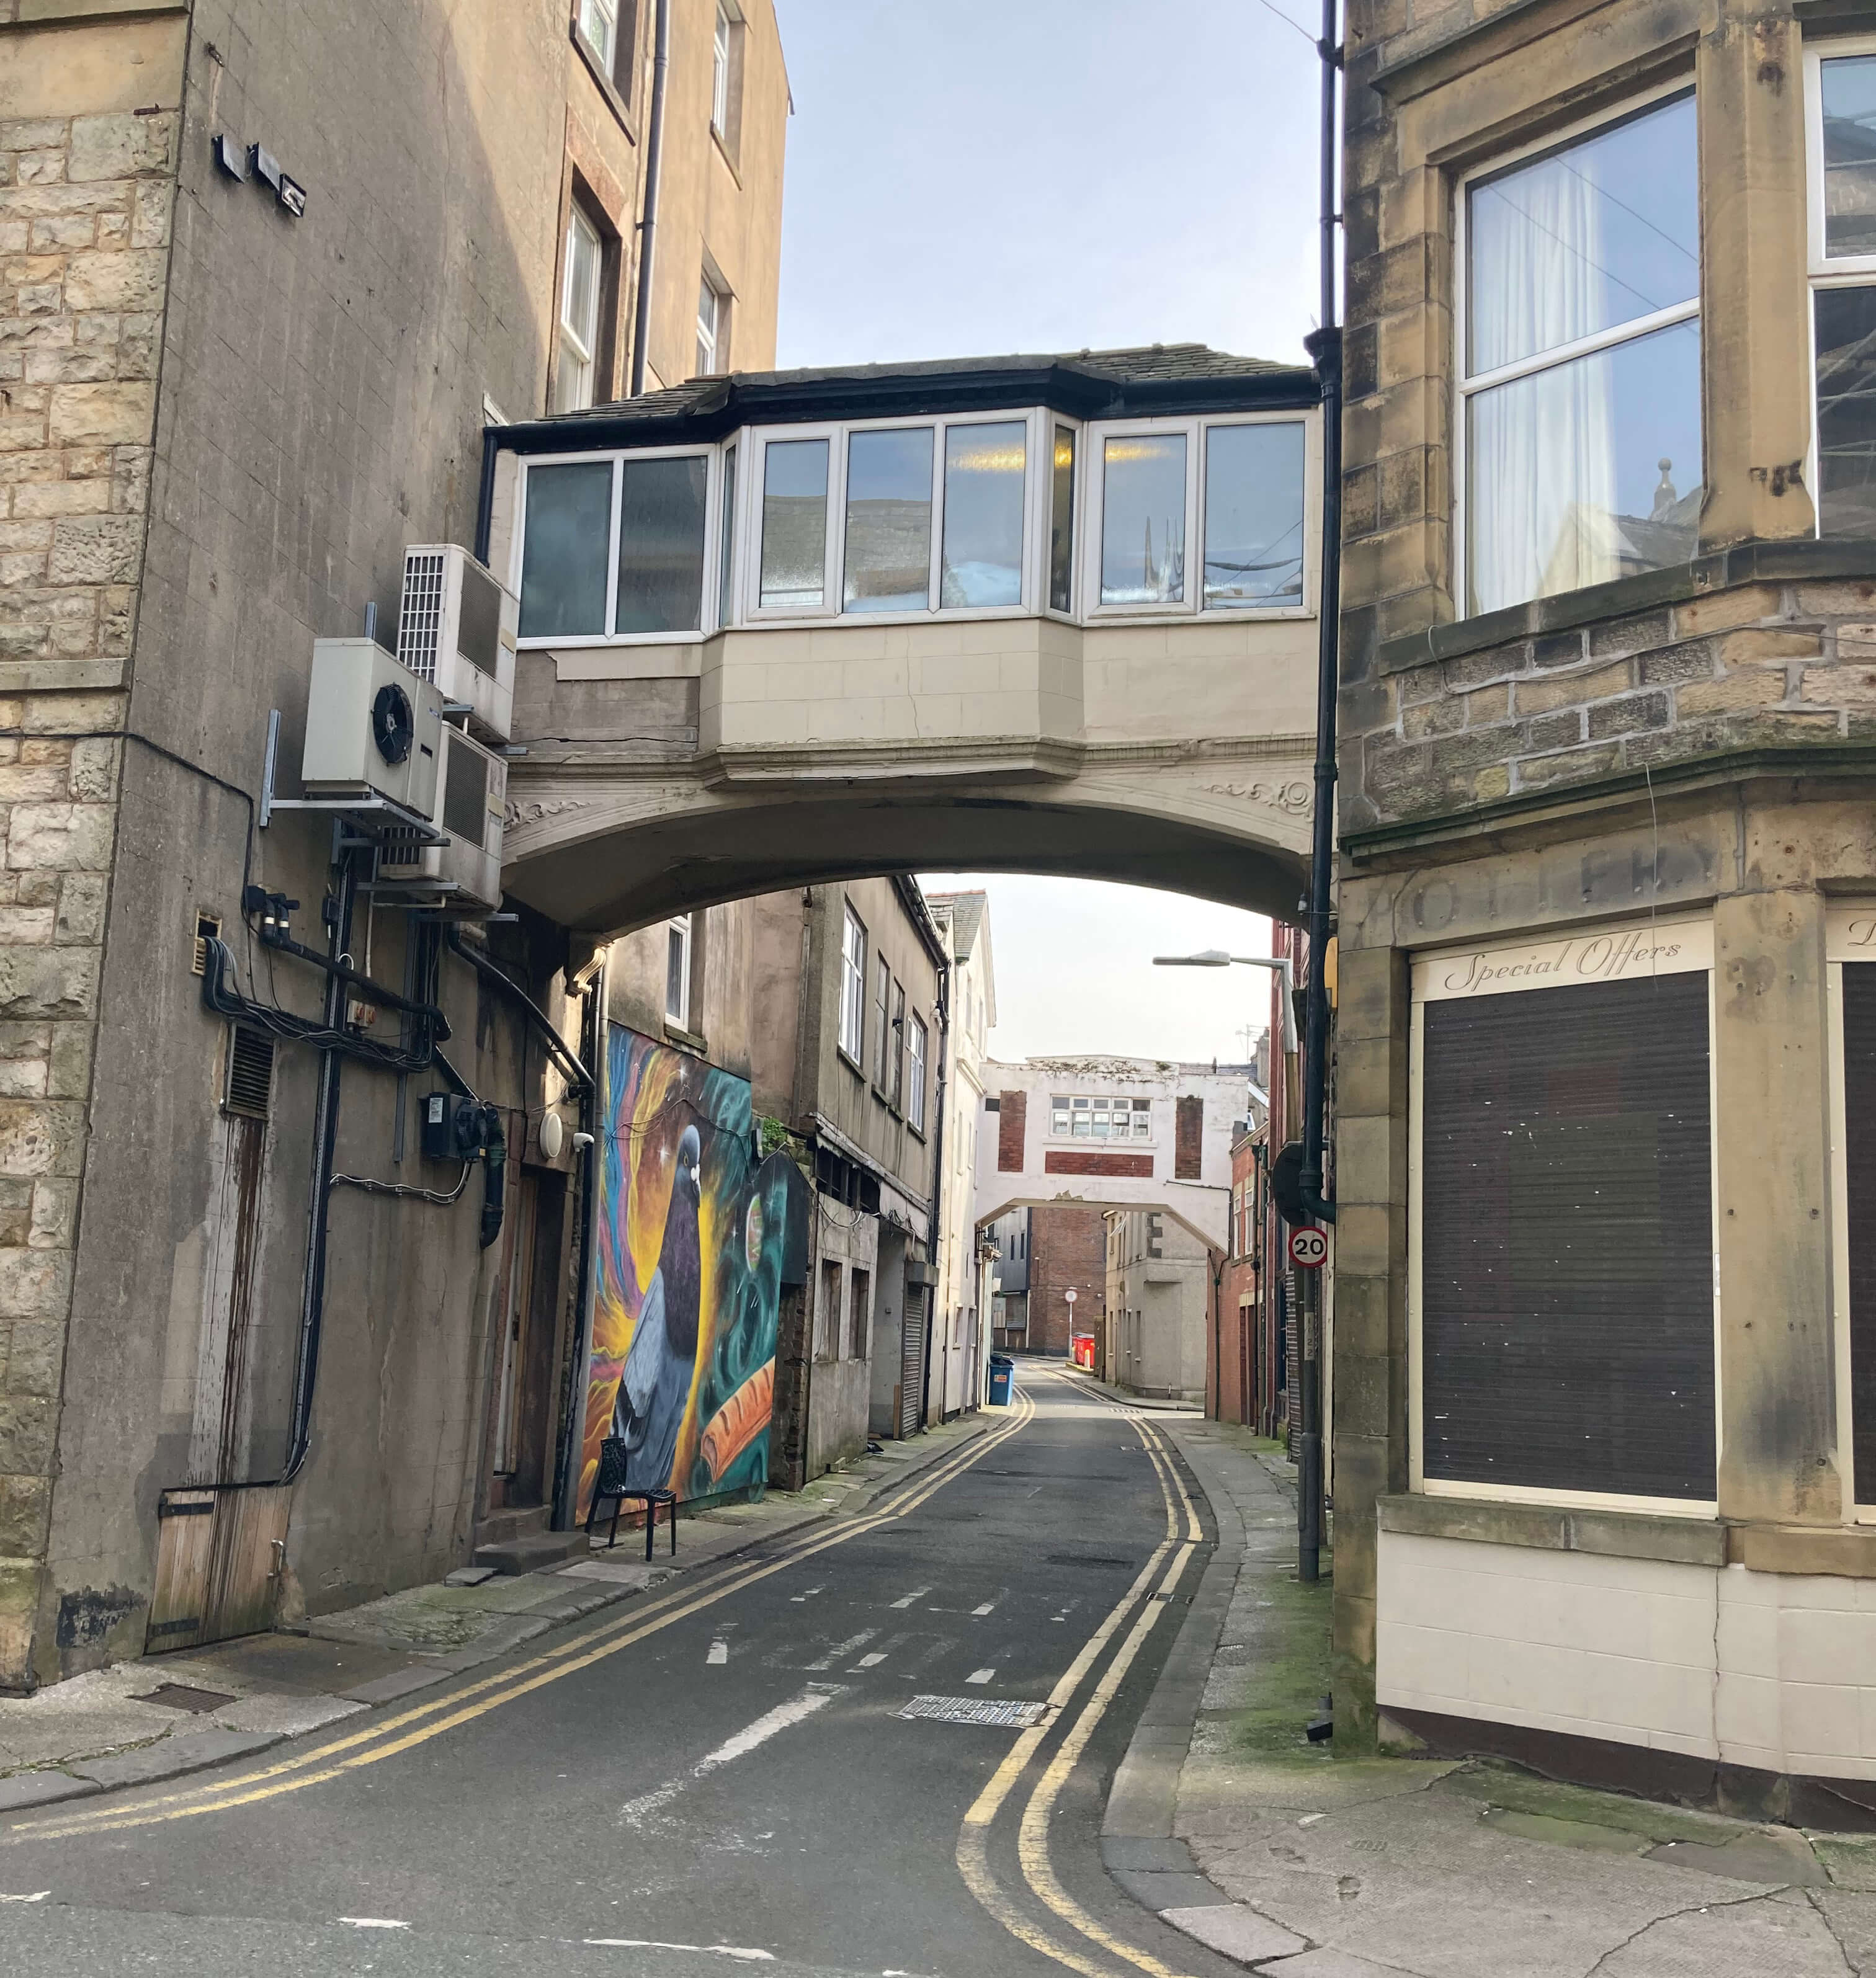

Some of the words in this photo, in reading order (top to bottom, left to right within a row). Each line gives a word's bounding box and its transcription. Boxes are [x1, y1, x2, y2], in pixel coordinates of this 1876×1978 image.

[1445, 941, 1573, 991] Special
[1576, 932, 1681, 976] Offers
[1295, 1239, 1324, 1255] 20
